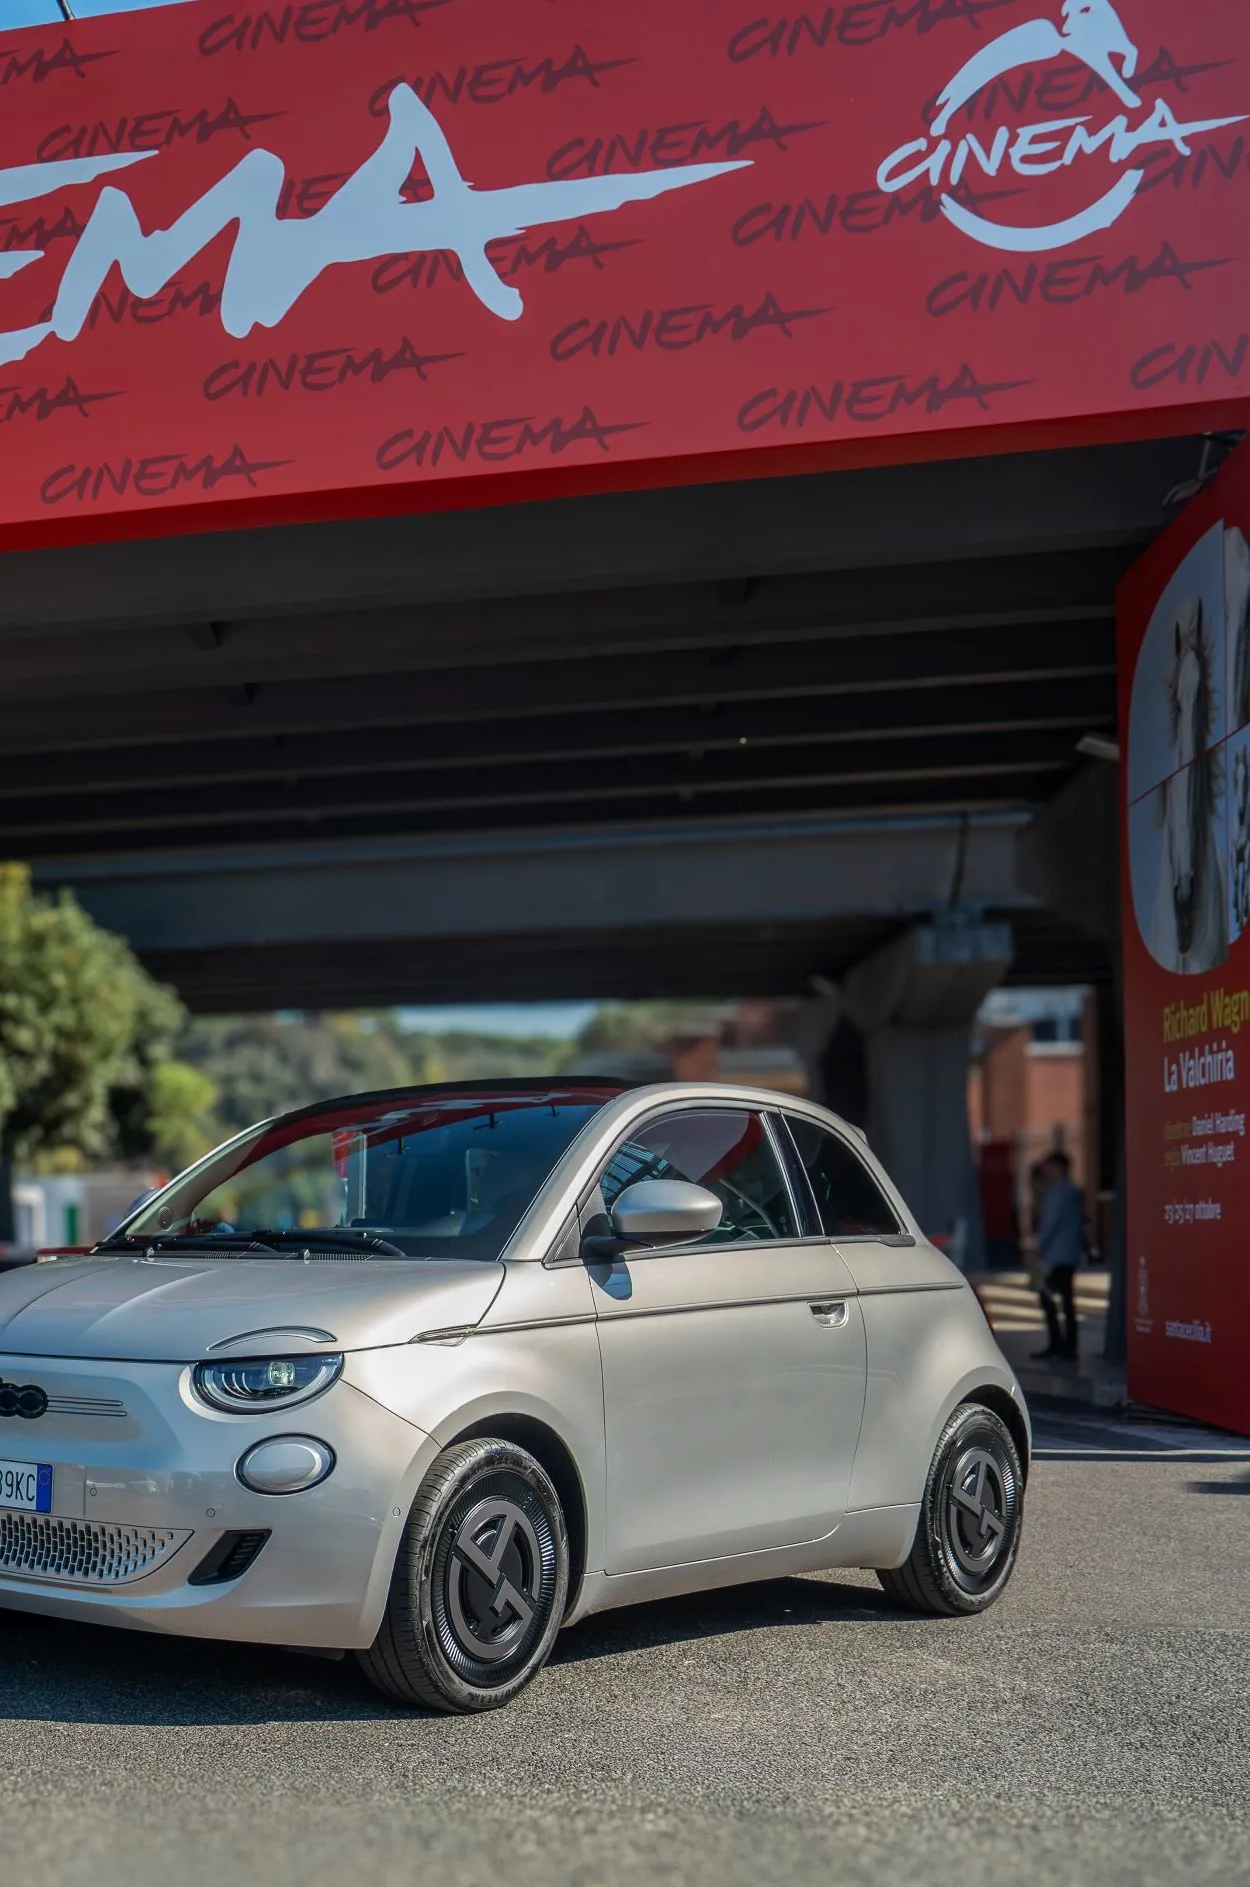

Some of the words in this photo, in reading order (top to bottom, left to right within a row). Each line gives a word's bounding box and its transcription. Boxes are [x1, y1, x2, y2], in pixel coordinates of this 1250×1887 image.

[198, 0, 450, 56] CINEMA
[727, 0, 1016, 62] CINEMA
[36, 97, 290, 163] CINEMA
[546, 105, 832, 180] CINEMA
[876, 98, 1250, 192] CINEMA
[1136, 136, 1250, 197] CIN
[924, 241, 1241, 317] CINEMA
[551, 292, 834, 361] CINEMA
[203, 337, 467, 400] CINEMA
[1129, 334, 1250, 390] CIN
[737, 363, 1036, 432] CINEMA
[375, 405, 651, 470] CINEMA
[39, 444, 297, 504] CINEMA
[1163, 990, 1208, 1043] Richard
[1164, 1057, 1178, 1092] La
[1180, 1039, 1235, 1089] Valchiria
